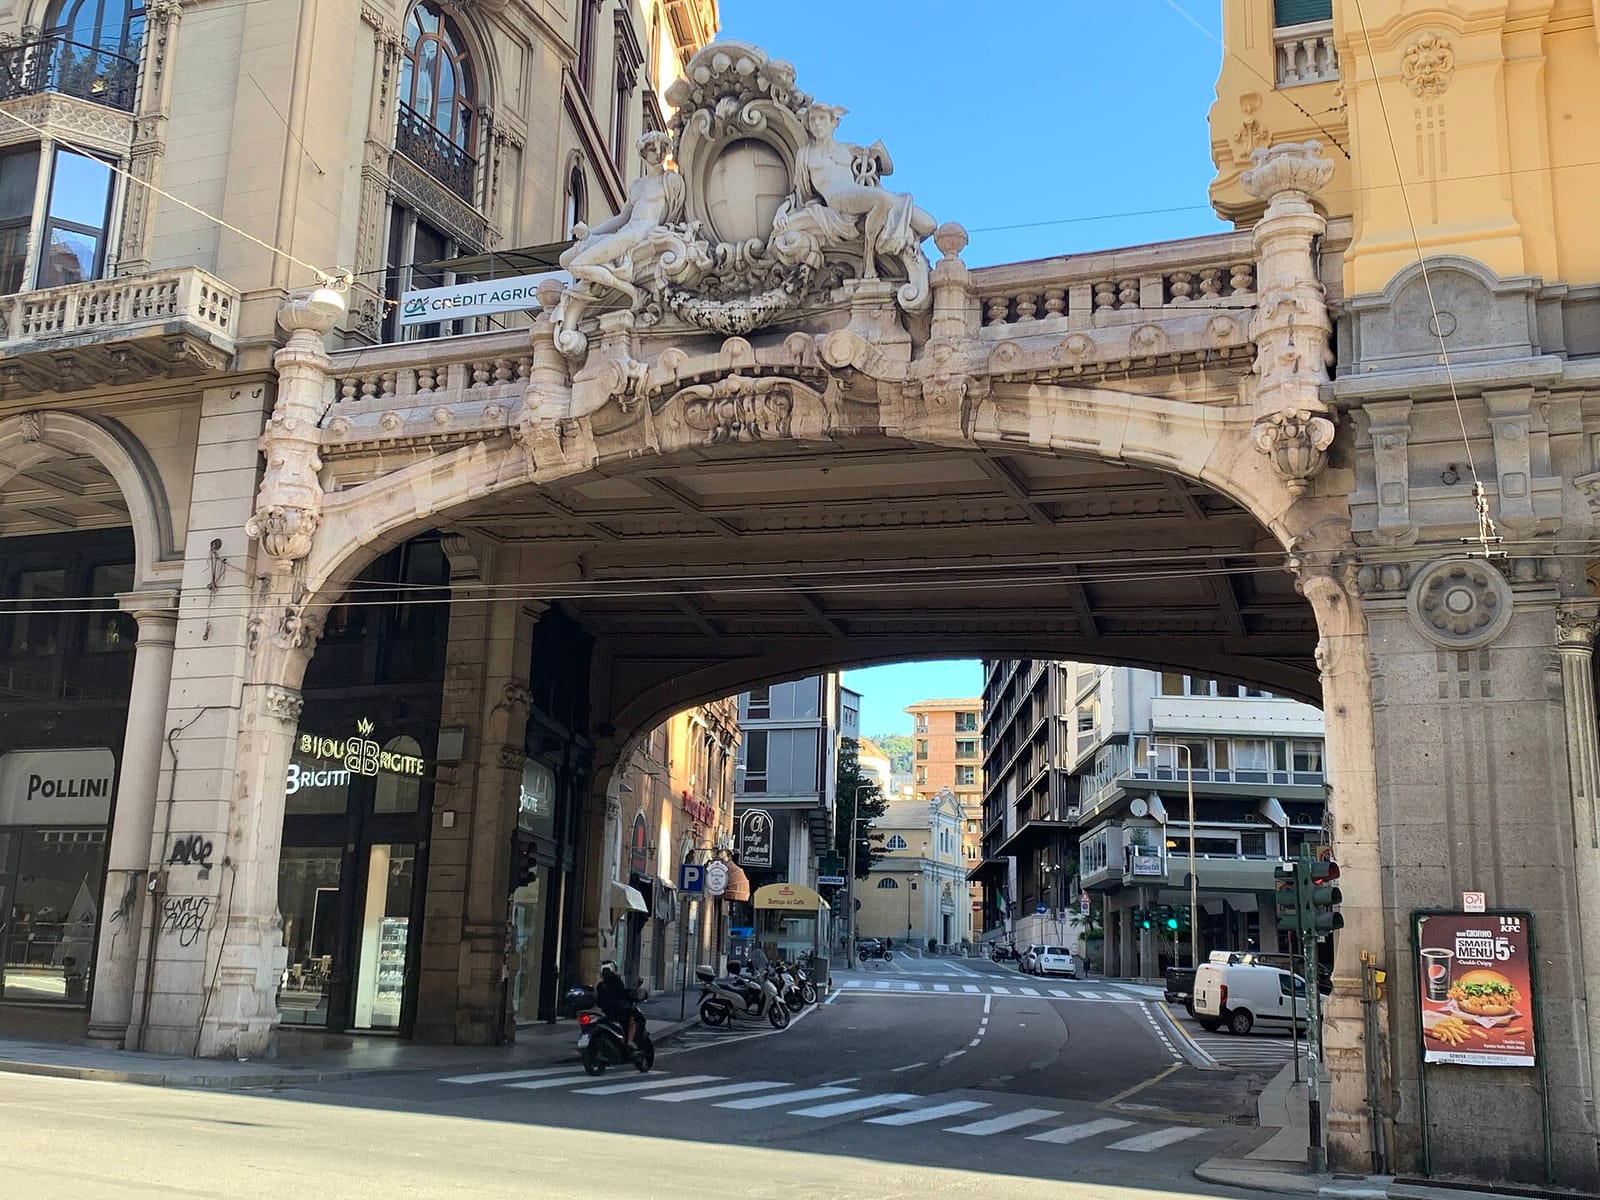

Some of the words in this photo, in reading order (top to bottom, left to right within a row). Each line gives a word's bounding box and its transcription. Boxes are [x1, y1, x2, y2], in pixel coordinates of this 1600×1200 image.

[431, 293, 487, 311] CRÉDIT
[301, 734, 345, 759] BIJOU
[27, 774, 109, 800] POLLINI
[285, 764, 350, 794] BRIGITT
[684, 867, 699, 889] P
[1500, 925, 1520, 933] KFC
[1458, 940, 1492, 948] SMART
[1458, 947, 1493, 958] MENU
